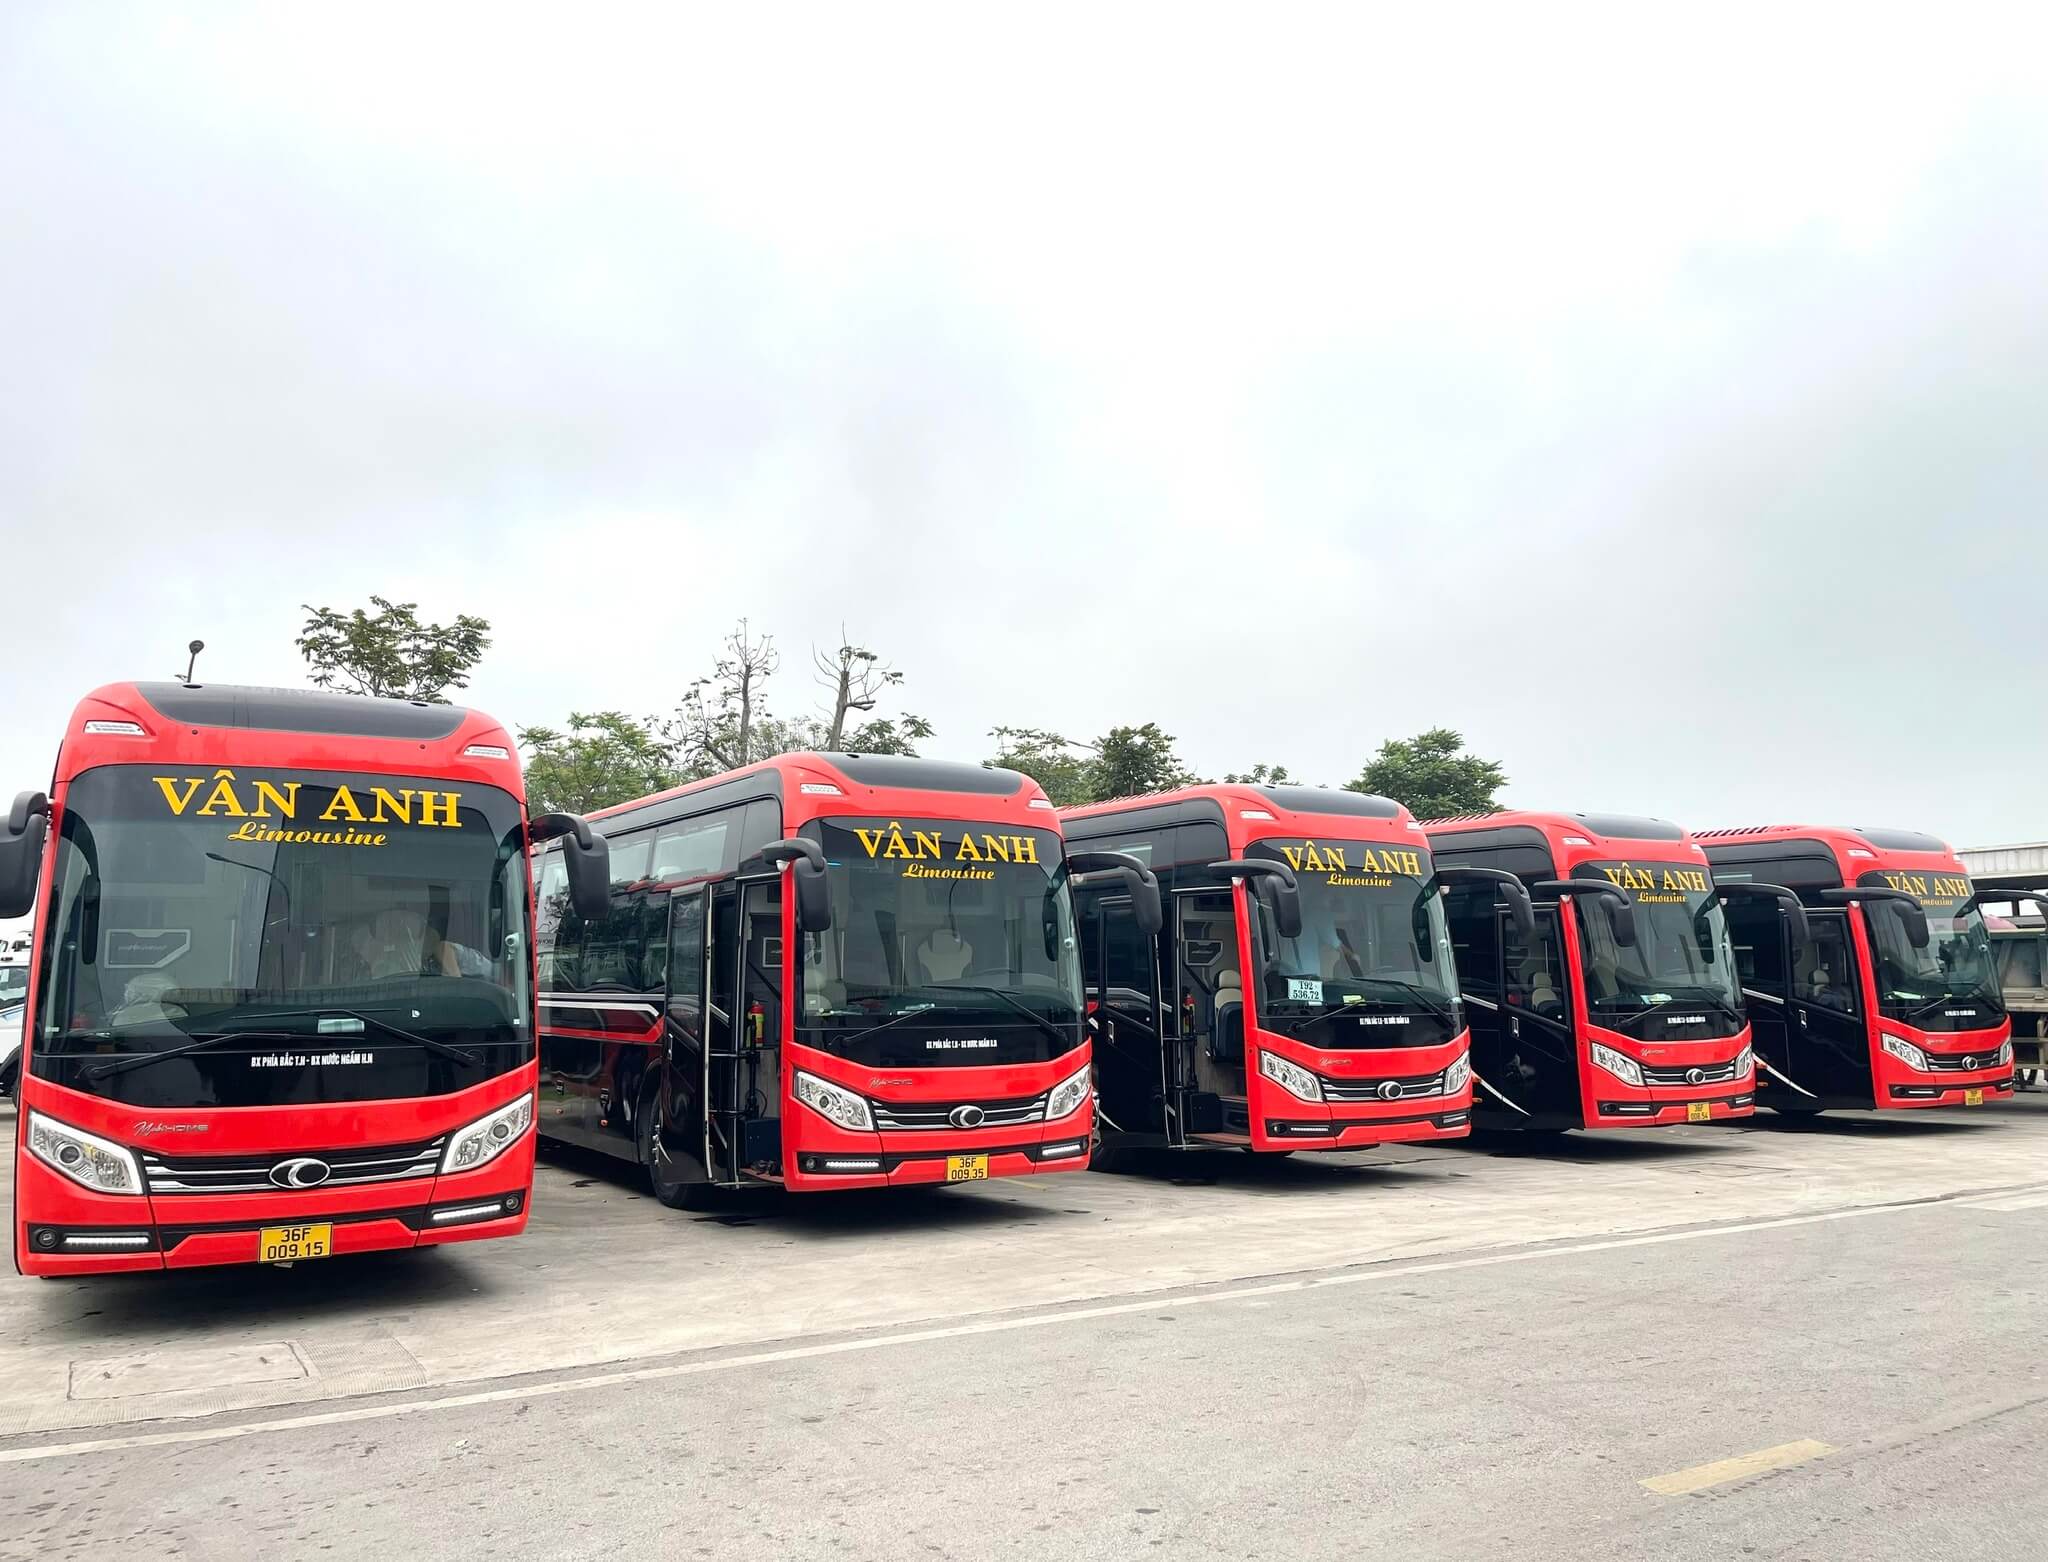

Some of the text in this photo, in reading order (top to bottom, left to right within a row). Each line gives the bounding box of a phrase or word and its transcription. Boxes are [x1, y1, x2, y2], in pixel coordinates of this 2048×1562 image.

[152, 769, 463, 827] VÂN ANH
[227, 821, 388, 846] Limousine
[853, 821, 1040, 864] VÂN ANH
[1280, 840, 1422, 876] VÂN ANH
[902, 863, 996, 880] Limousine
[1326, 872, 1393, 887] Limousine
[1603, 862, 1708, 891] VÂN ANH
[1934, 877, 1970, 897] ANH
[1293, 989, 1320, 1000] 536.72
[959, 1157, 977, 1168] 36F
[951, 1168, 984, 1179] 009.35
[281, 1227, 312, 1242] 36F
[267, 1241, 324, 1259] 009.15
